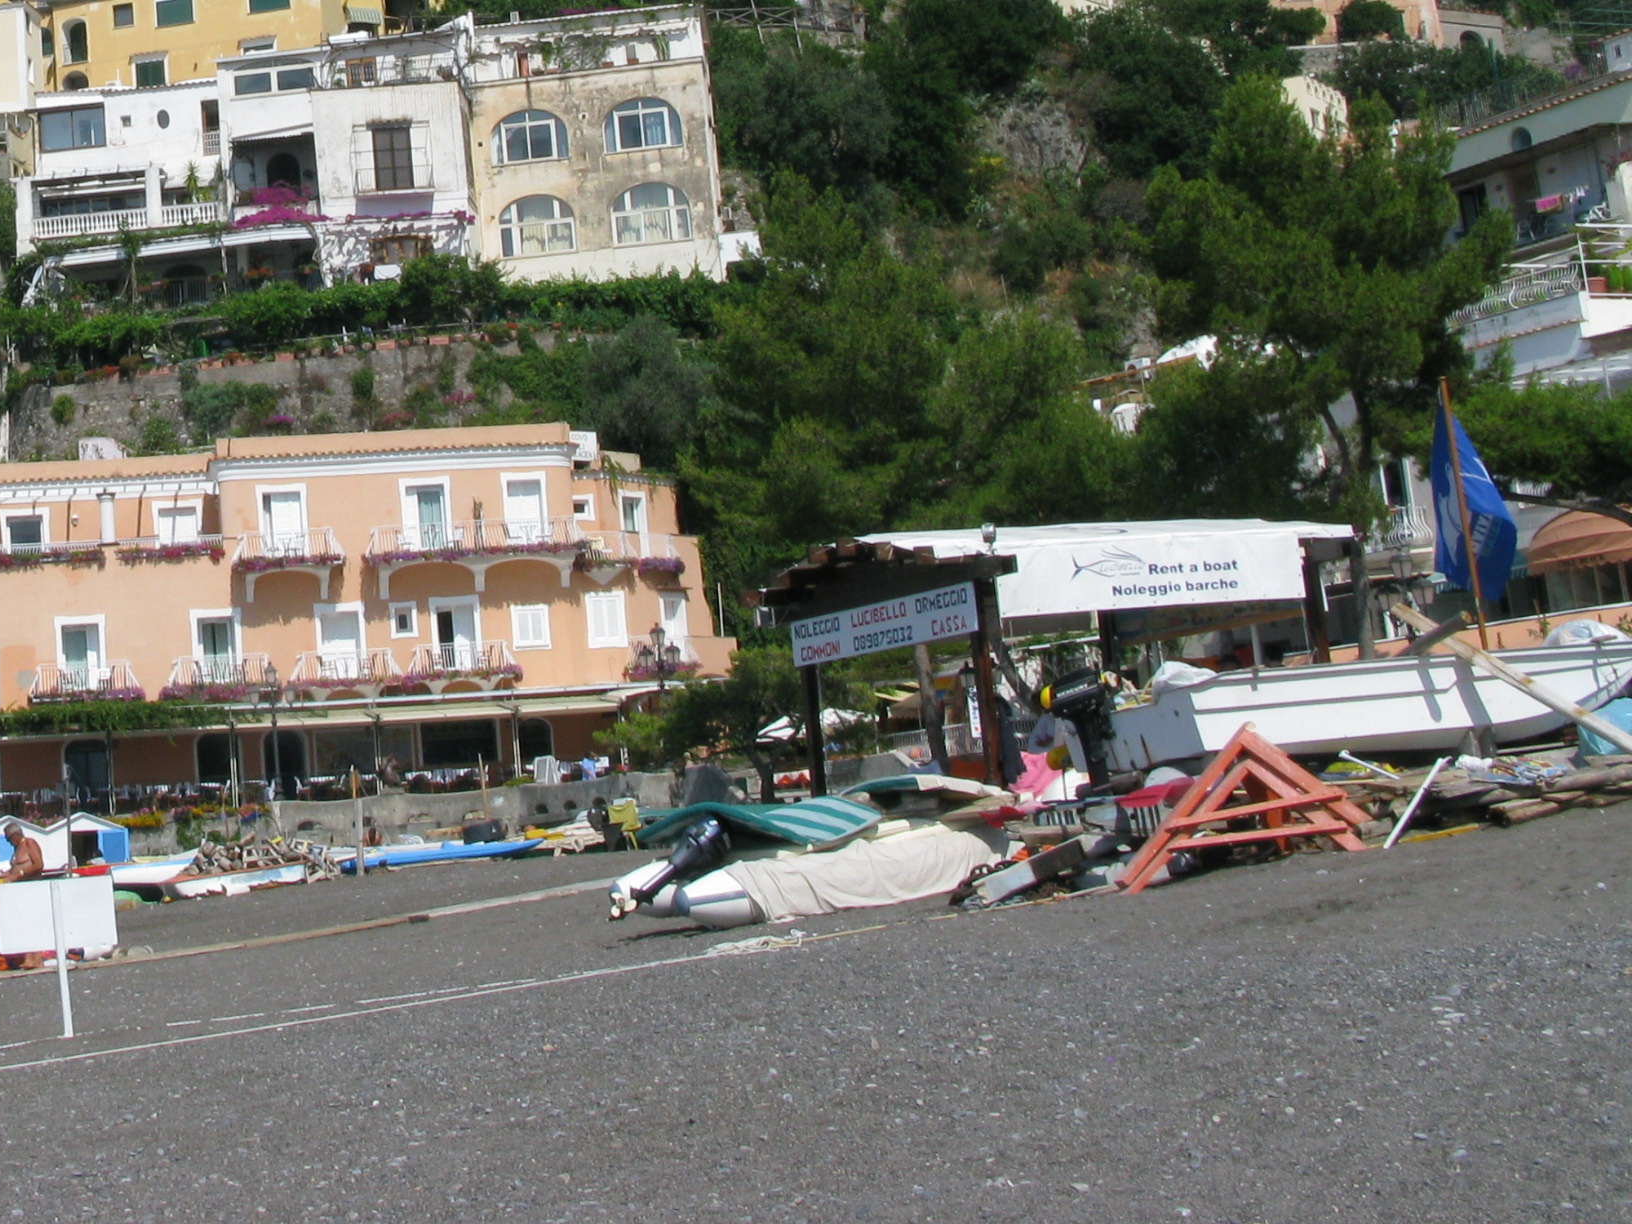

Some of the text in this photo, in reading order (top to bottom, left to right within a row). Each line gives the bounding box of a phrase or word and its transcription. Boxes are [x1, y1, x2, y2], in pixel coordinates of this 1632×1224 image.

[1148, 559, 1238, 576] Rent a boat
[1112, 579, 1238, 597] Noleggio barche
[794, 587, 967, 640] NOLEGGIO LUCIBELLO ORMEGGIO
[800, 615, 968, 662] GOMMONI 089875032 CASSA
[1056, 683, 1088, 698] MERCURY
